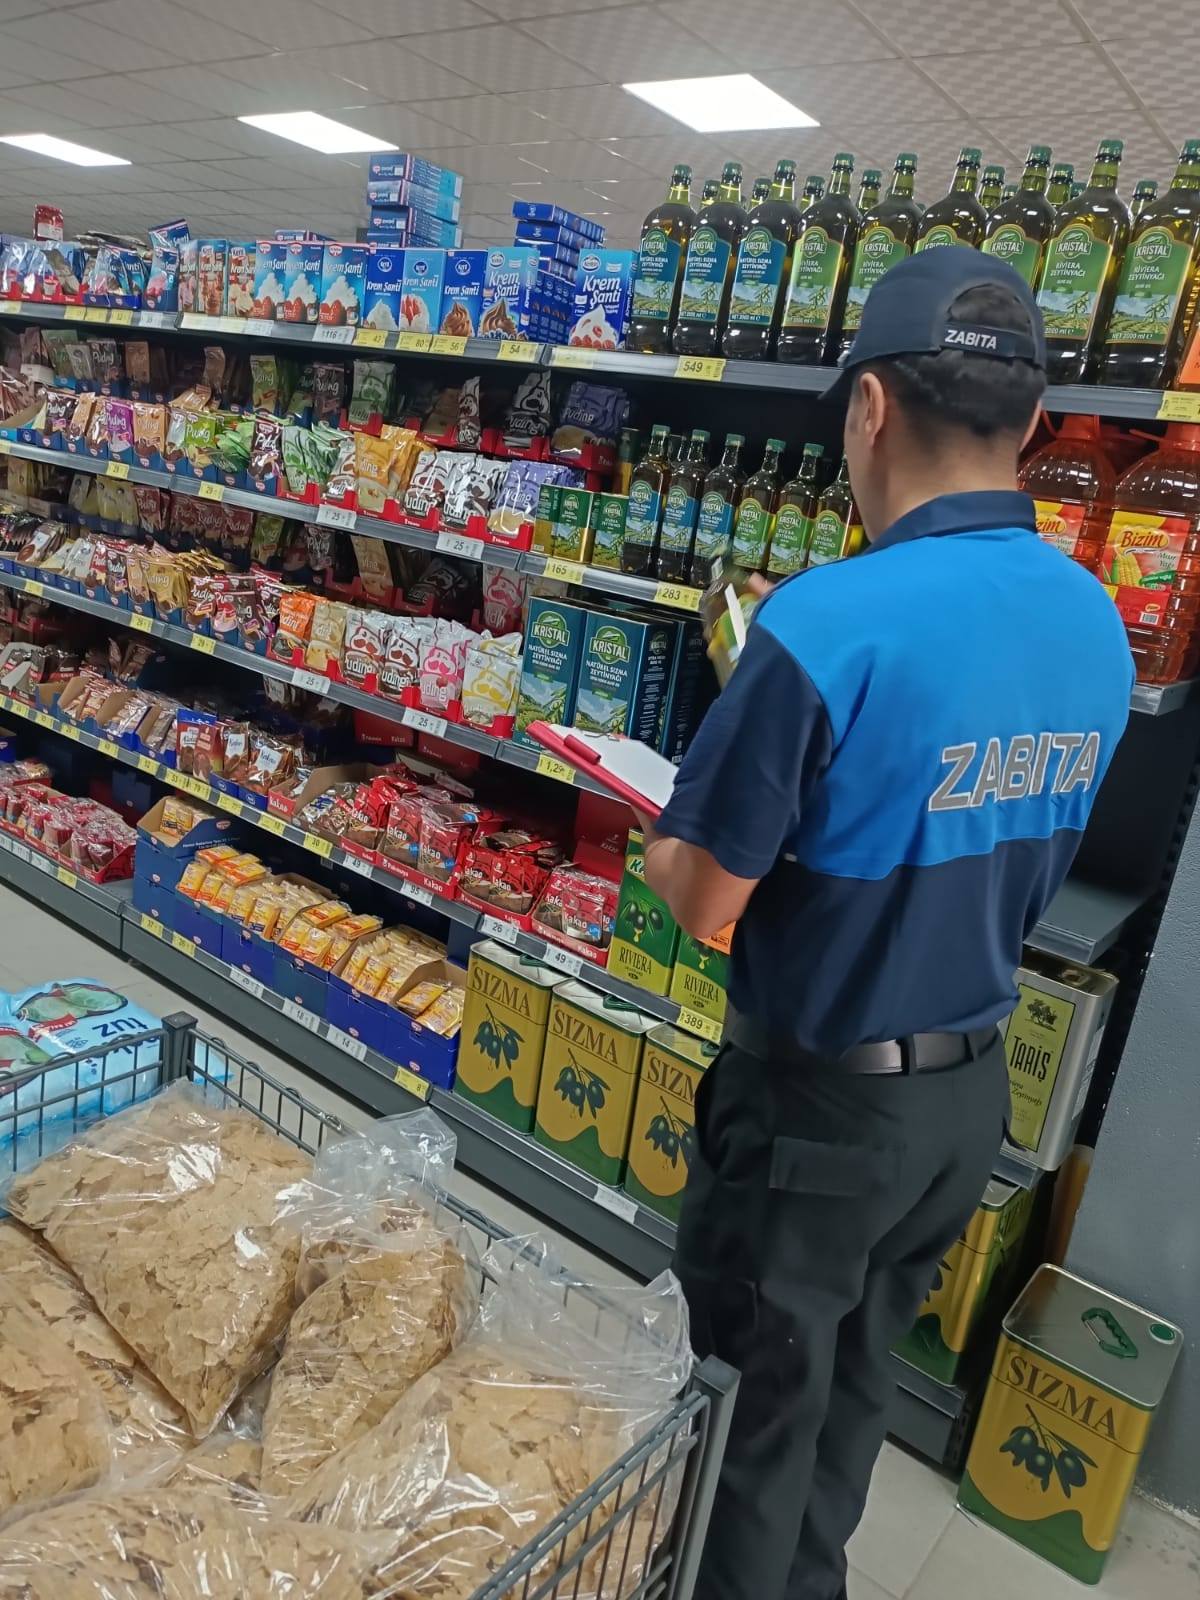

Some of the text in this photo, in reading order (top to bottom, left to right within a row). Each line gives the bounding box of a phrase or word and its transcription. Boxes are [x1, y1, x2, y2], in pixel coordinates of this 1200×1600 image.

[864, 243, 891, 253] KRISTAL
[992, 242, 1020, 252] KRISTAL
[1058, 242, 1088, 253] KRISTAL
[1137, 246, 1168, 256] KRISTAL
[489, 270, 519, 286] Krem
[583, 275, 620, 292] Krem
[494, 283, 520, 301] Şanti
[590, 288, 622, 309] Şanti
[945, 330, 998, 350] ZABITA
[509, 345, 520, 354] 54
[683, 362, 703, 372] 549
[1037, 518, 1061, 533] zim
[454, 540, 464, 550] 25
[1121, 531, 1164, 548] Bizim
[552, 564, 567, 575] 165
[662, 588, 681, 600] 283
[534, 624, 566, 643] KRISTAL
[592, 640, 626, 660] KRISTAL
[346, 658, 376, 676] uding
[422, 683, 448, 702] uding
[418, 718, 428, 728] 25
[928, 732, 1100, 812] ZABITA
[423, 877, 444, 893] Kakao
[555, 953, 566, 964] 49
[620, 946, 652, 975] RIVIERA
[472, 966, 532, 1018] SIZMA
[684, 973, 719, 1003] RIVIERA
[92, 1017, 148, 1038] tuz
[684, 1014, 704, 1030] 389
[552, 1008, 619, 1065] SIZMA
[646, 1056, 696, 1102] SIZM
[1007, 1355, 1119, 1441] SIZMA
